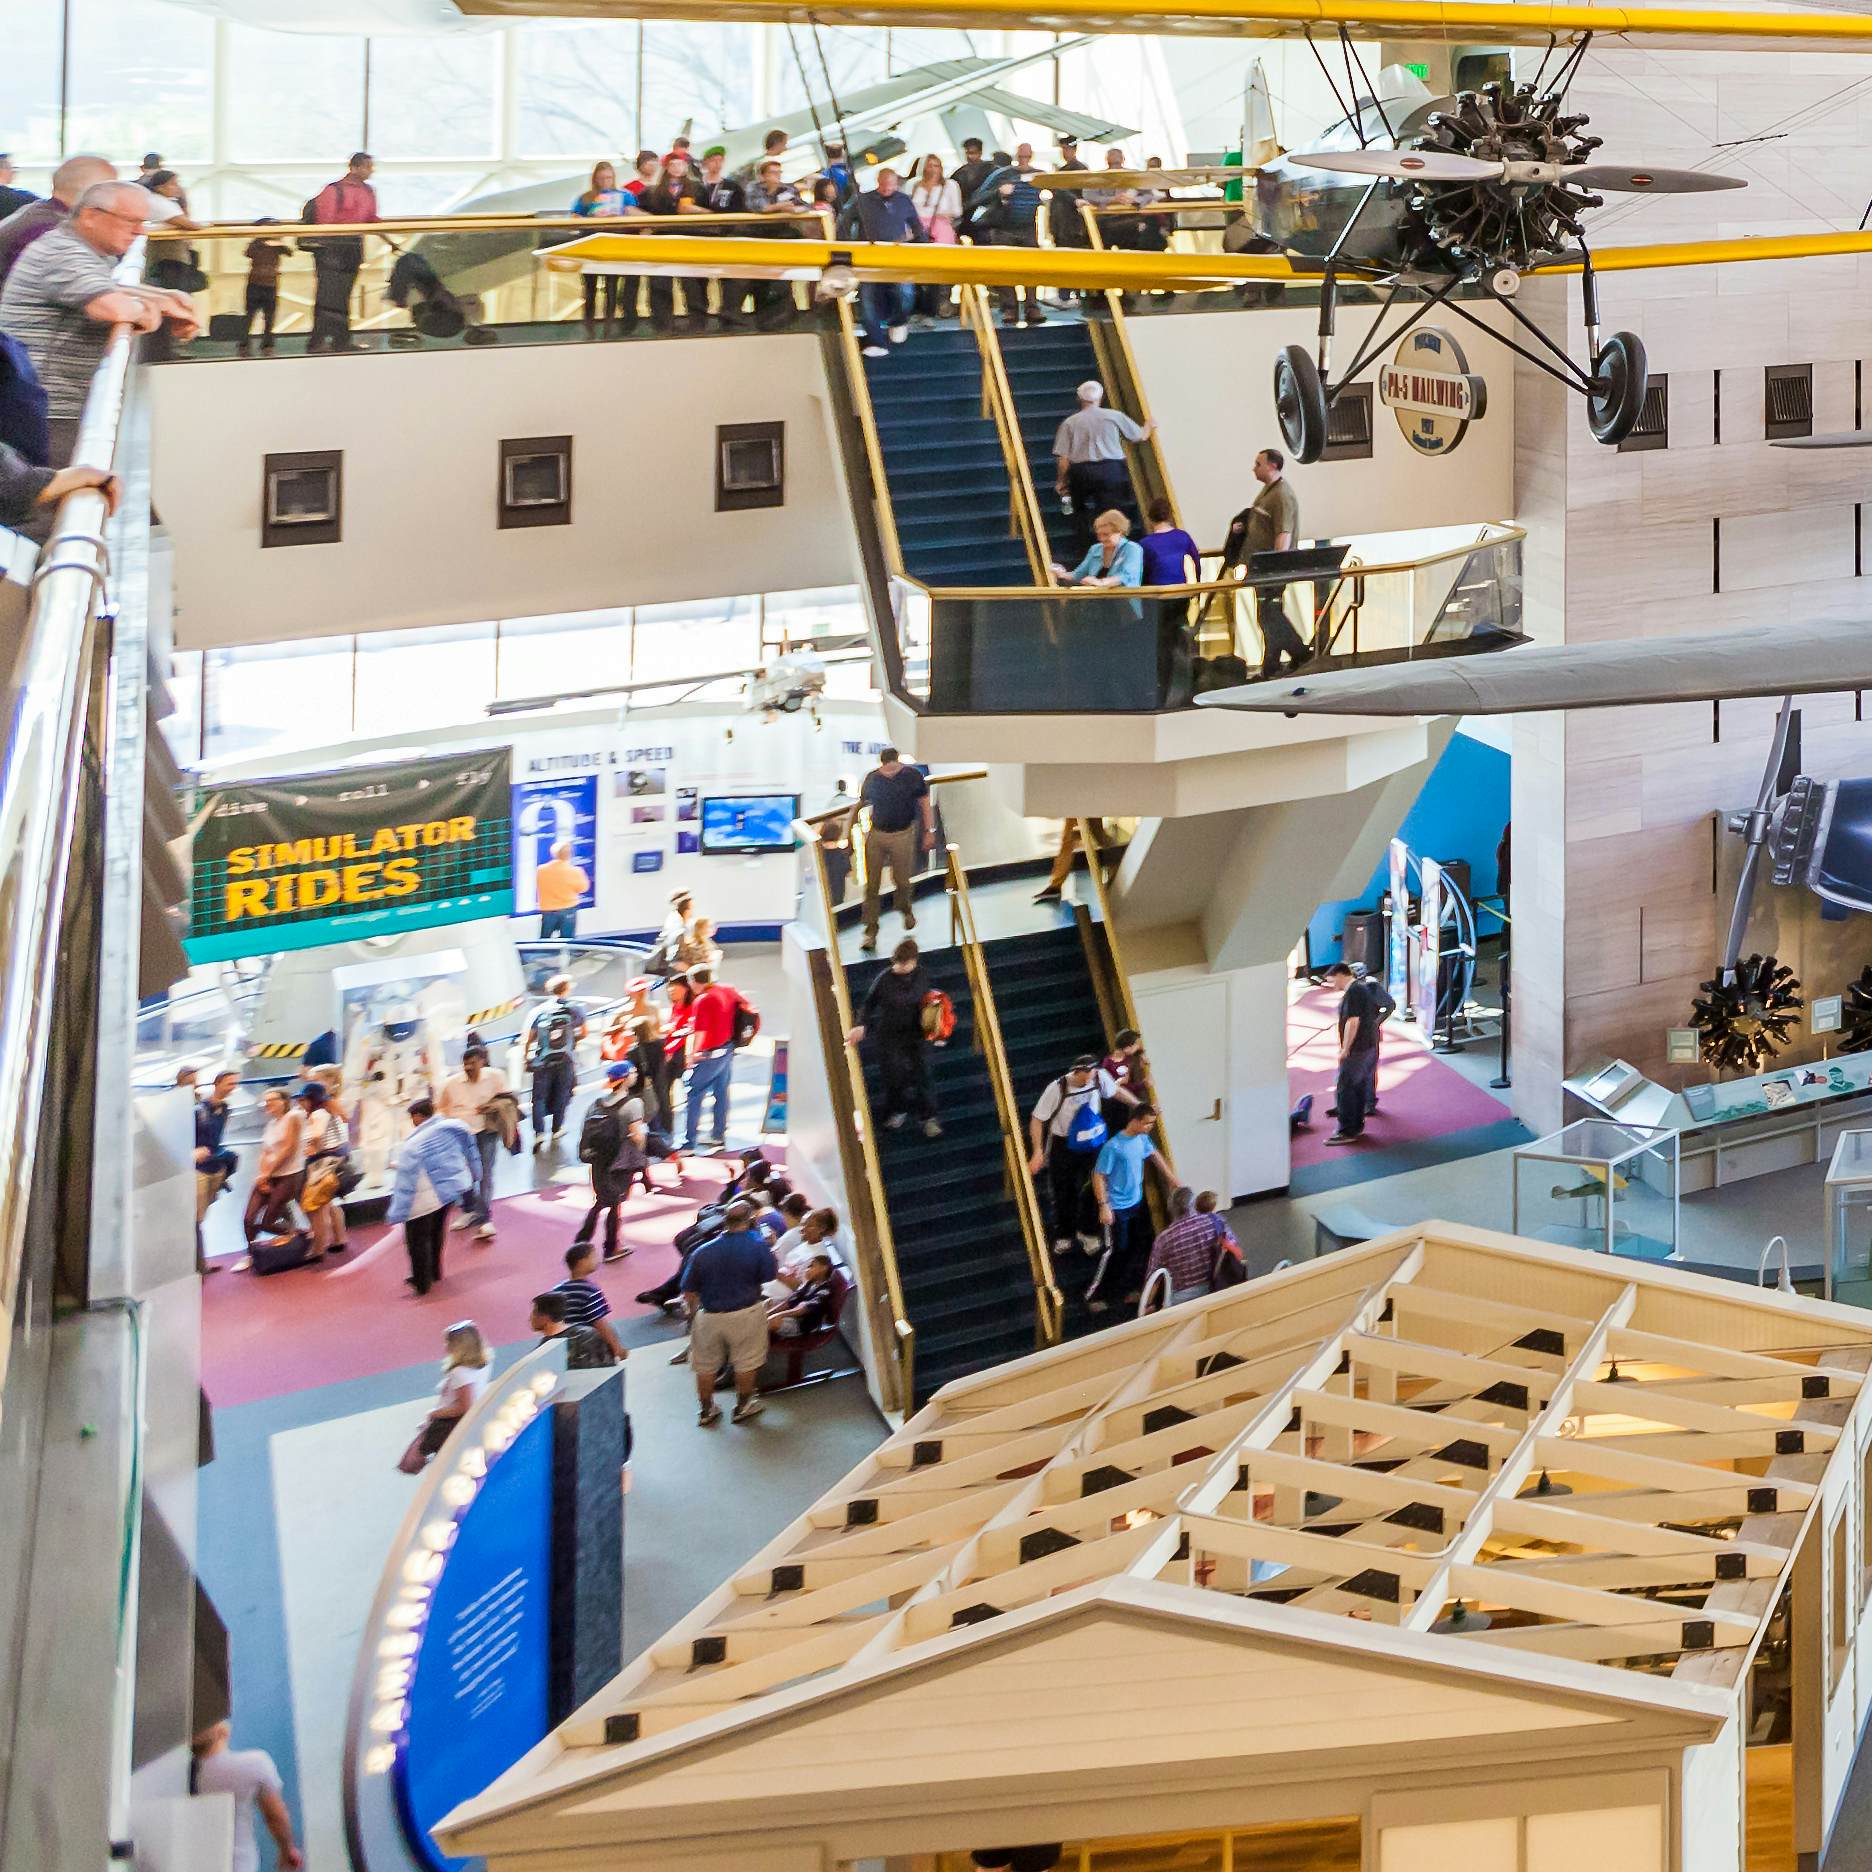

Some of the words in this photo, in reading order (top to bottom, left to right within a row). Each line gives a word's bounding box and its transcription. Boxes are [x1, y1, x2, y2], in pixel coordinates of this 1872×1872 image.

[1388, 372, 1408, 401] PA-5
[1412, 375, 1463, 410] MAILWING
[529, 751, 601, 773] ALTITUDE
[607, 747, 618, 765] &
[625, 746, 673, 763] SPEED
[226, 815, 477, 875] SIMULATOR
[225, 857, 423, 922] RIDES
